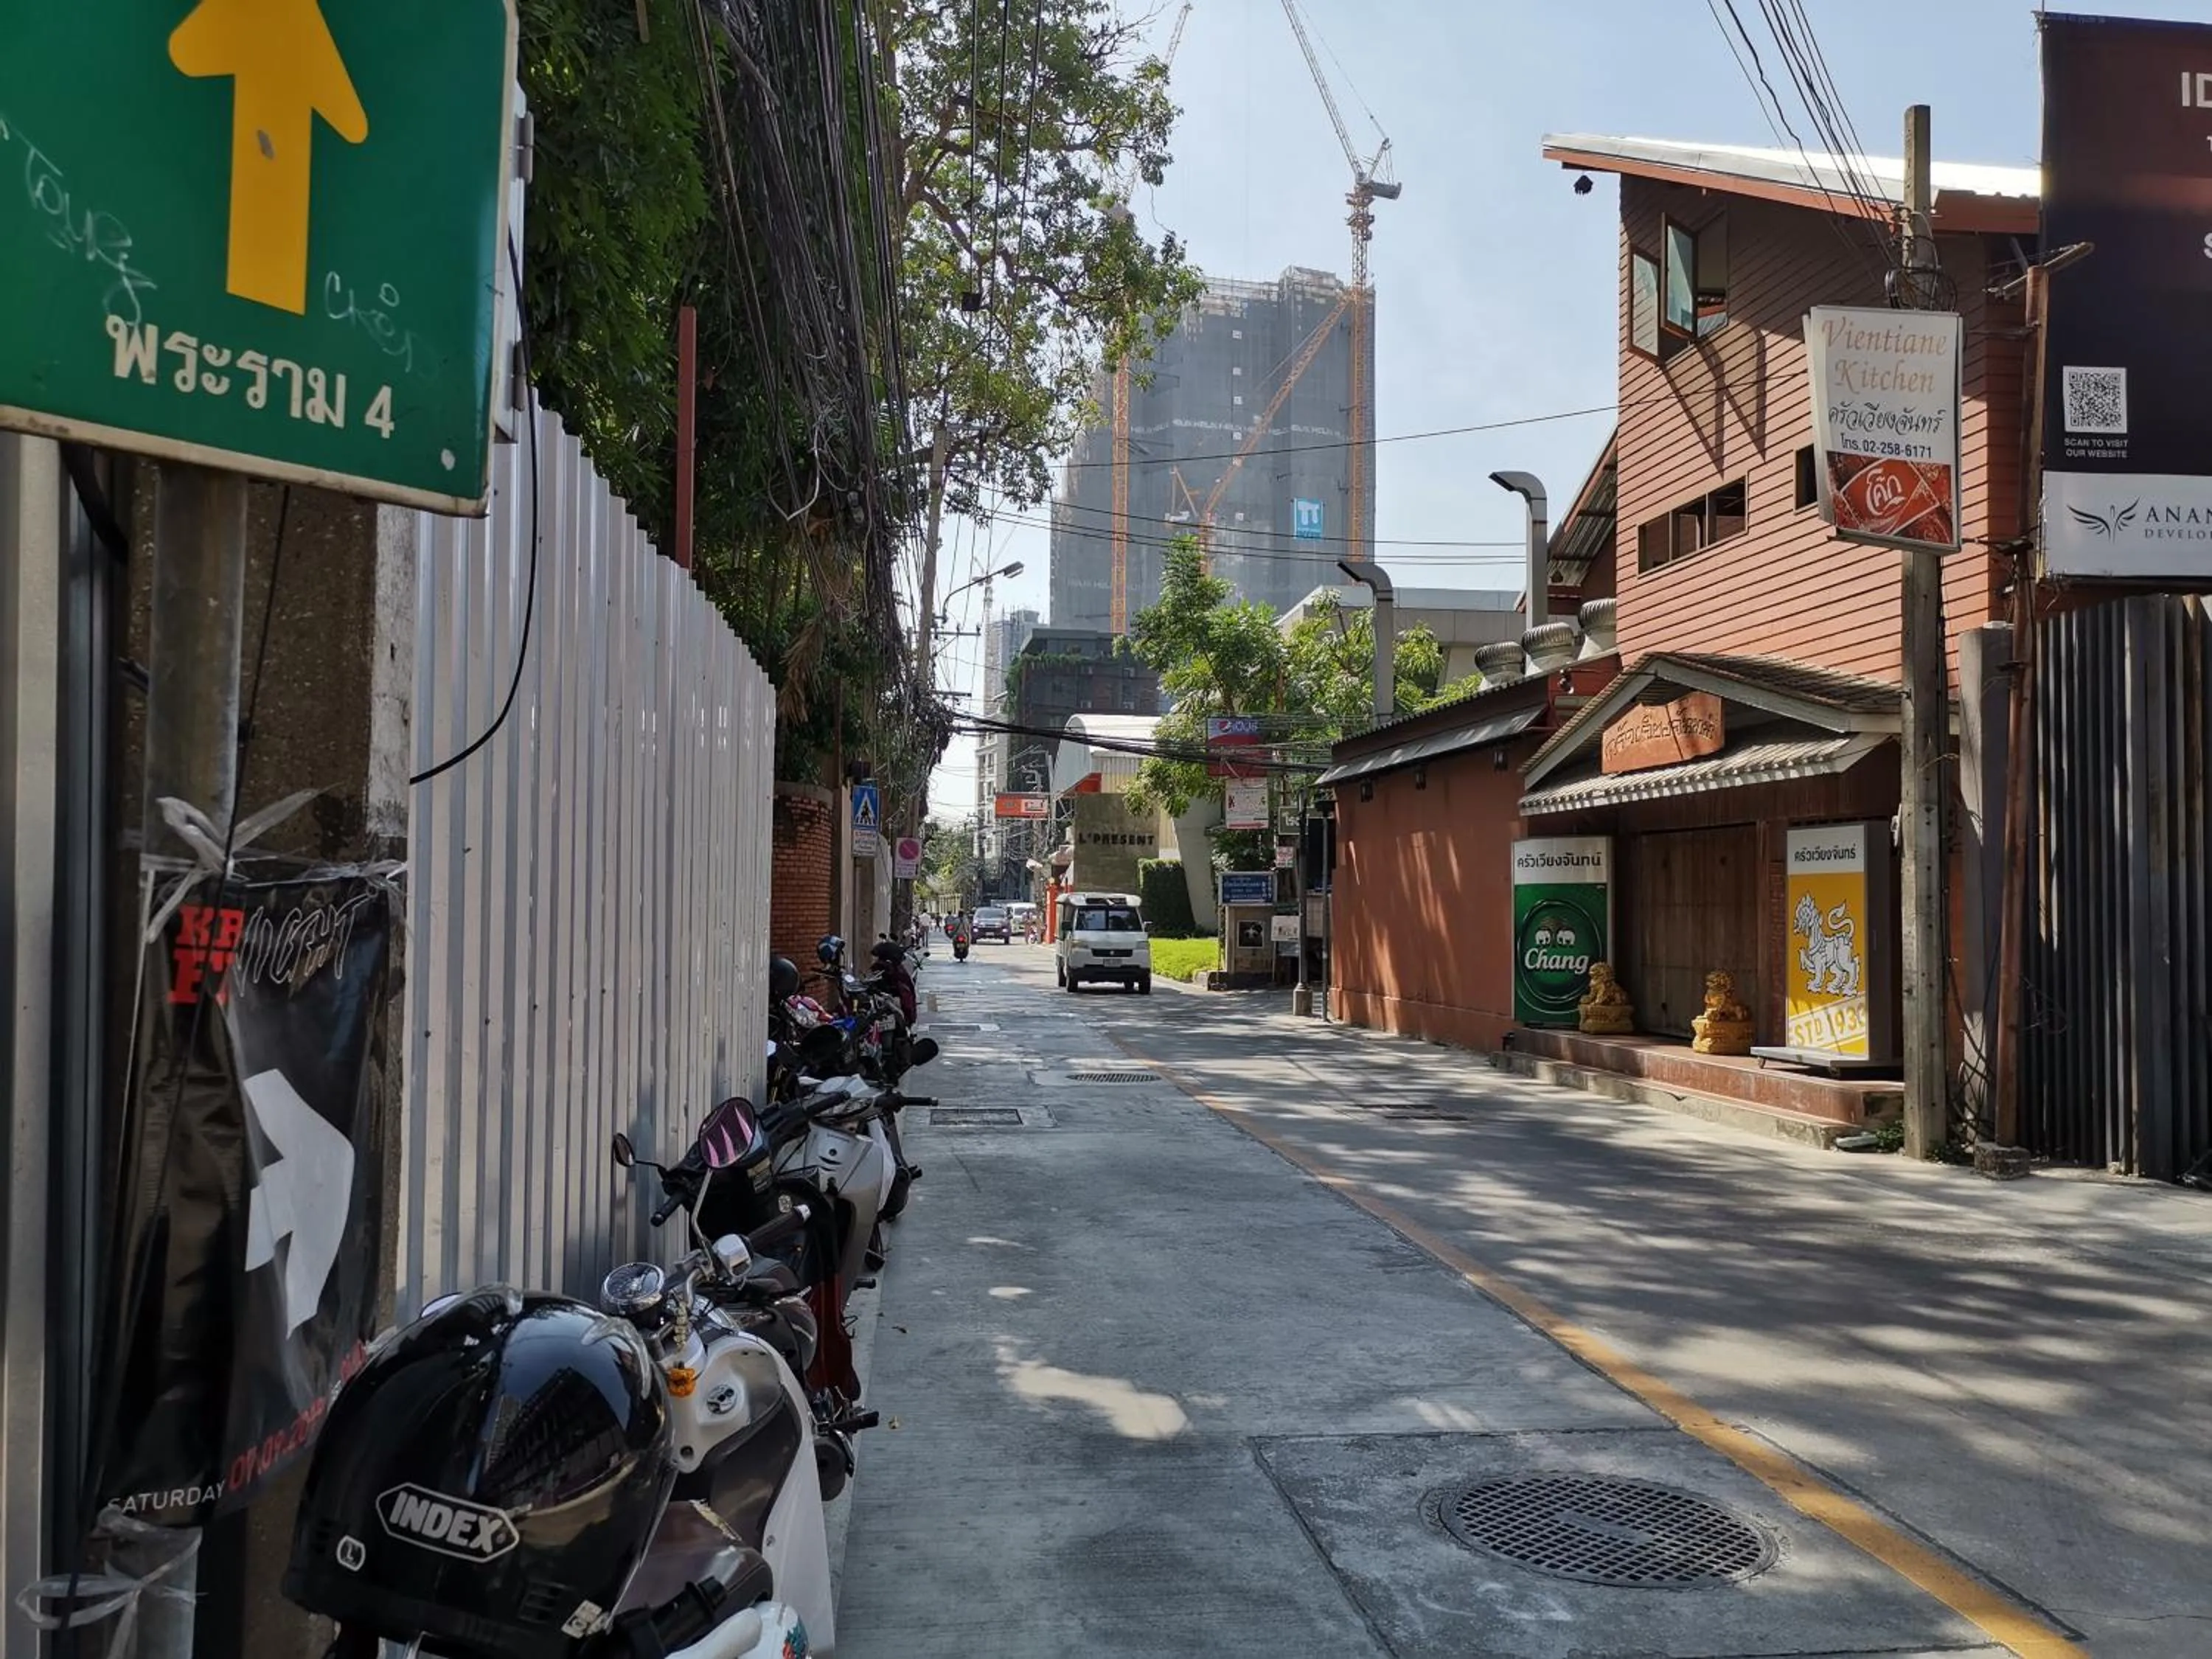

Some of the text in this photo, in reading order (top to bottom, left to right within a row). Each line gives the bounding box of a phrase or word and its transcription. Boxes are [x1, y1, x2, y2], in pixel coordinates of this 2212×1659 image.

[1821, 316, 1947, 356] Vientiane
[105, 315, 346, 428] พระราม
[364, 386, 394, 439] 4
[1834, 358, 1935, 394] Kitchen
[1863, 439, 1932, 458] 02-258-6171
[2065, 437, 2128, 448] SCAN TO VISIT
[2065, 448, 2127, 458] OUR WEBSITE
[2145, 529, 2212, 540] DEVELO
[1524, 947, 1589, 974] Chang
[108, 1480, 225, 1514] SATURDAY
[389, 1490, 503, 1554] INDEX
